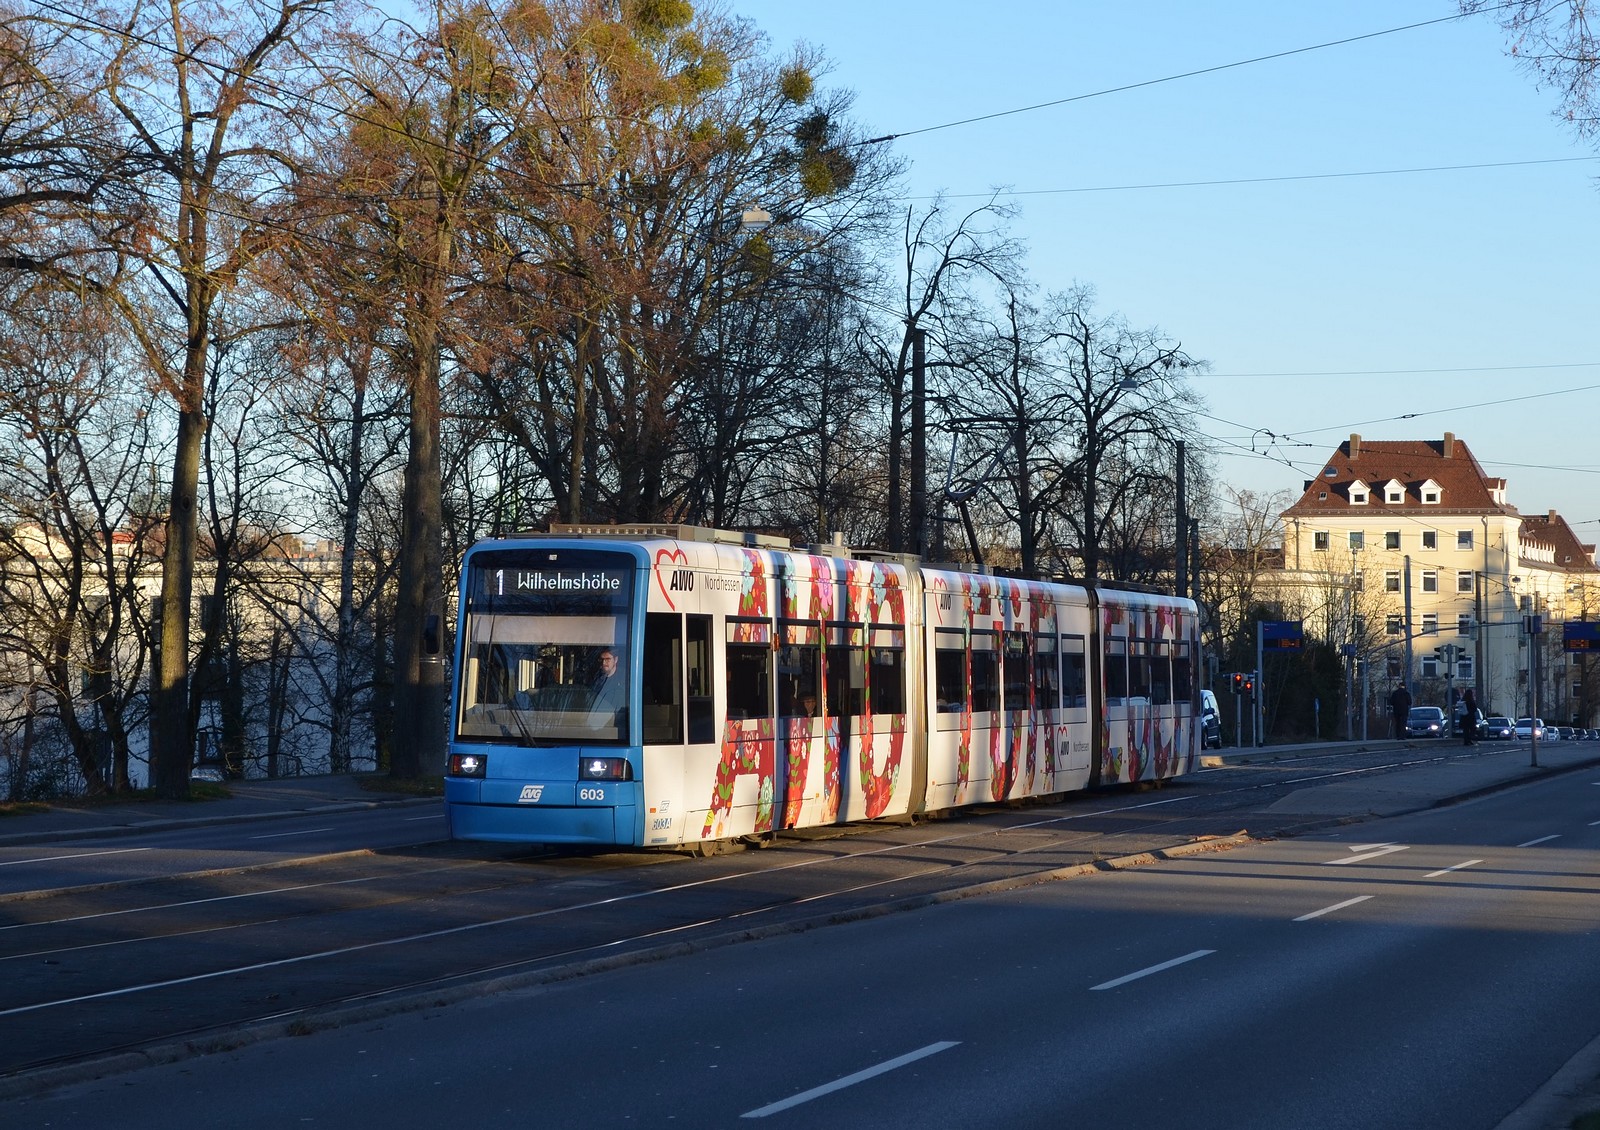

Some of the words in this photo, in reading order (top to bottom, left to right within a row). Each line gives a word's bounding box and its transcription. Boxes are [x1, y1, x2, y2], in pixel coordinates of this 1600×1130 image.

[496, 569, 504, 596] 1
[517, 572, 620, 590] Wilhelmshöhe
[670, 570, 695, 592] AWO
[704, 574, 740, 592] Nordhessen
[520, 788, 542, 799] KVG
[580, 788, 604, 800] 603
